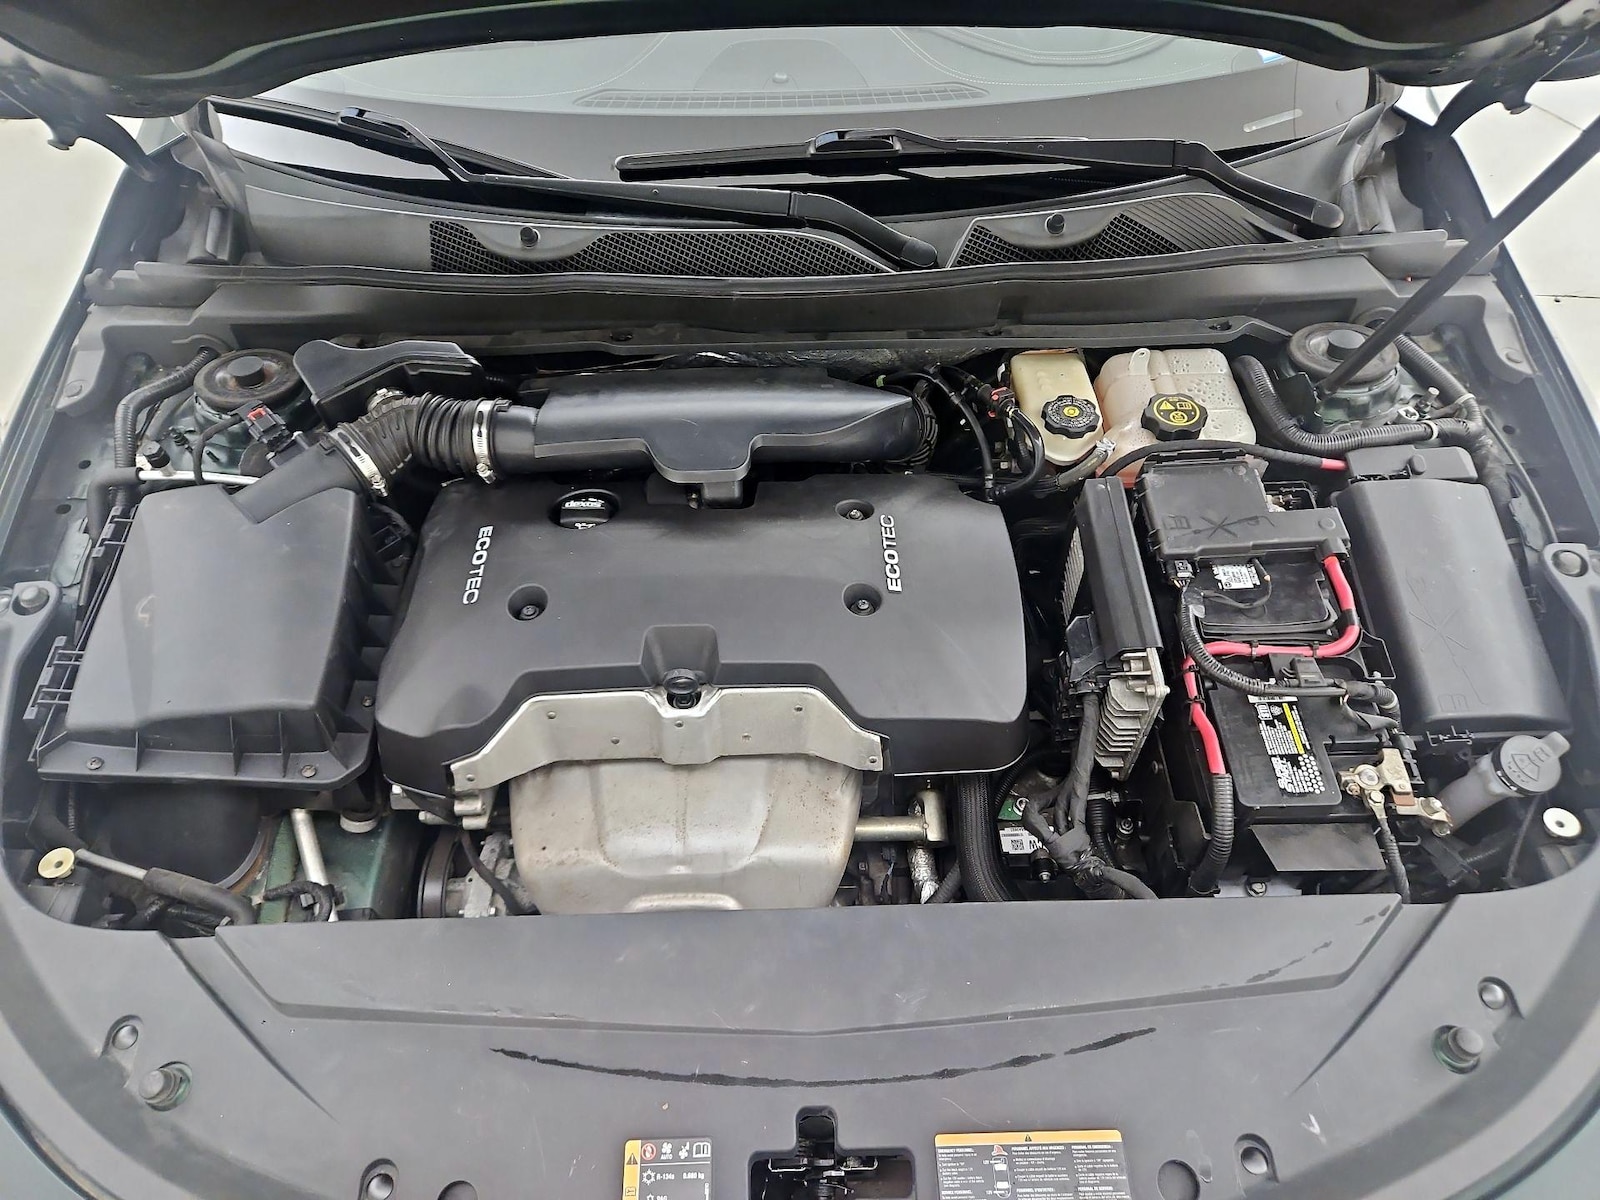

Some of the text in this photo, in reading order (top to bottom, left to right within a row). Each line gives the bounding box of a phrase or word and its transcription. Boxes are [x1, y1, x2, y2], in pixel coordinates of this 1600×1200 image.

[565, 500, 602, 508] dexos
[462, 525, 494, 605] ECOTEC
[880, 514, 902, 592] ECOTEC
[698, 1172, 705, 1180] kg
